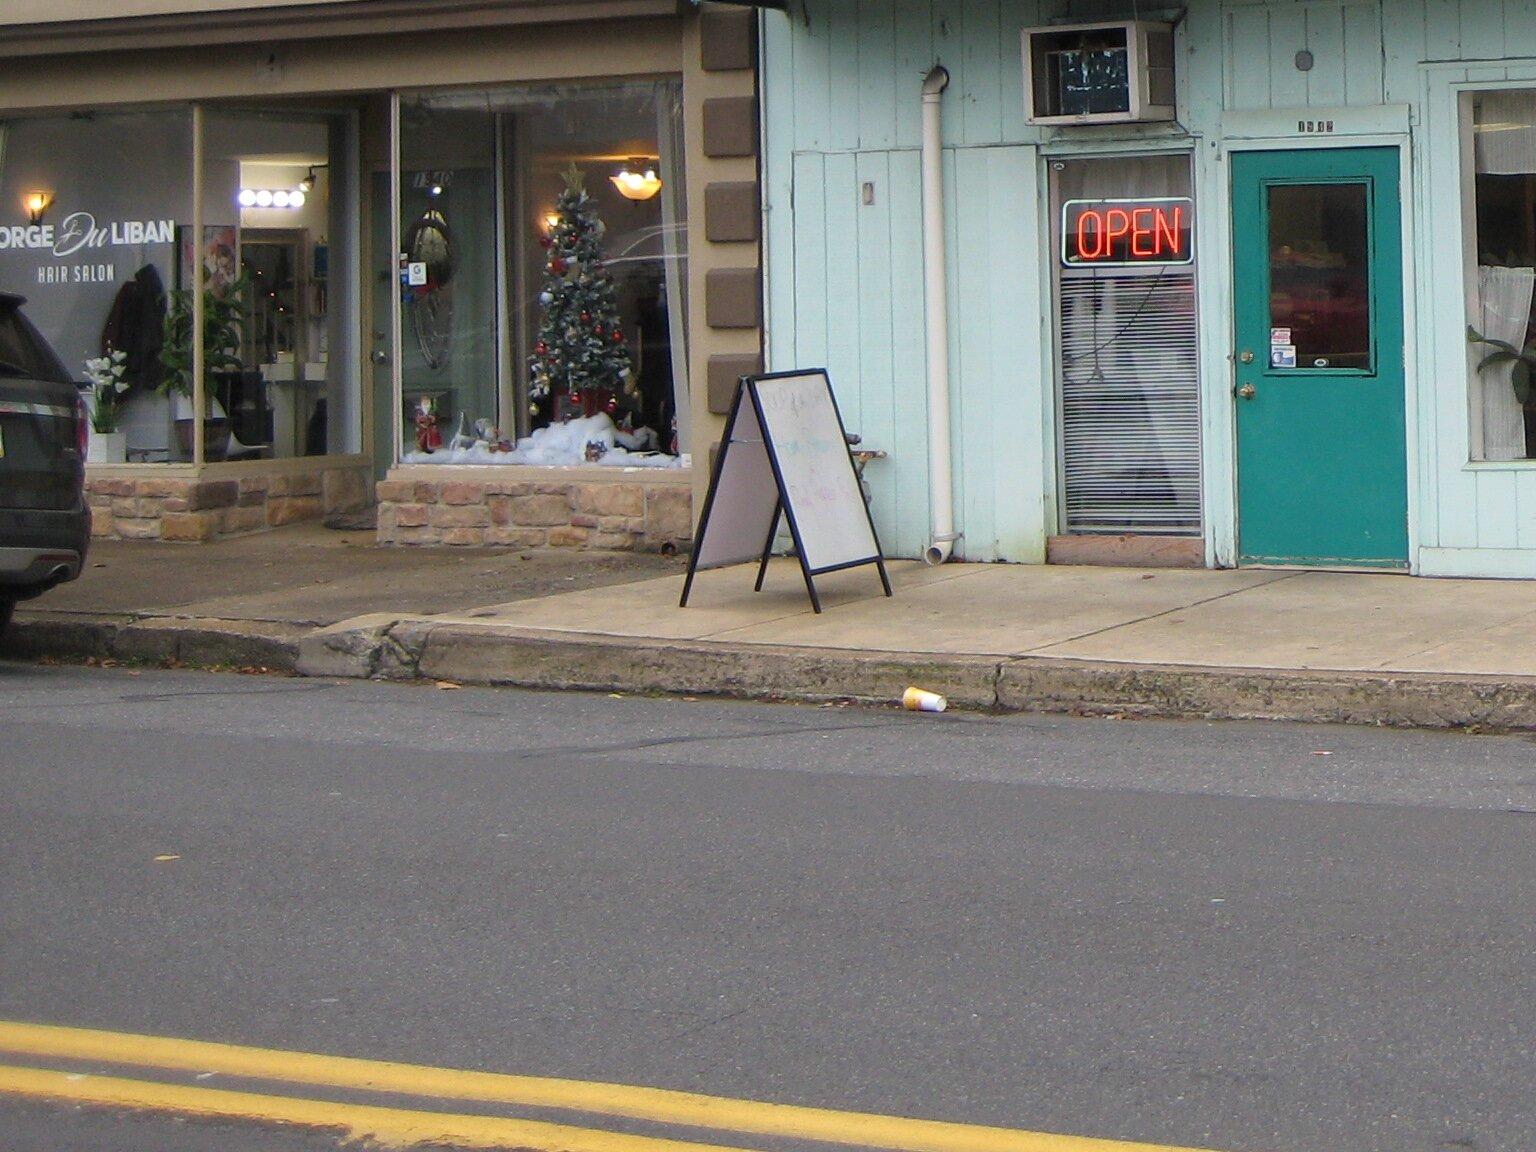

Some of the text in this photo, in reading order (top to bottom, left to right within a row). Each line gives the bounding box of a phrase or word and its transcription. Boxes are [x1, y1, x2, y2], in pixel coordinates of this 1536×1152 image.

[53, 212, 108, 257] Du
[111, 220, 174, 245] LIBAN
[1078, 207, 1181, 258] OPEN
[38, 264, 115, 283] HAIR SALON
